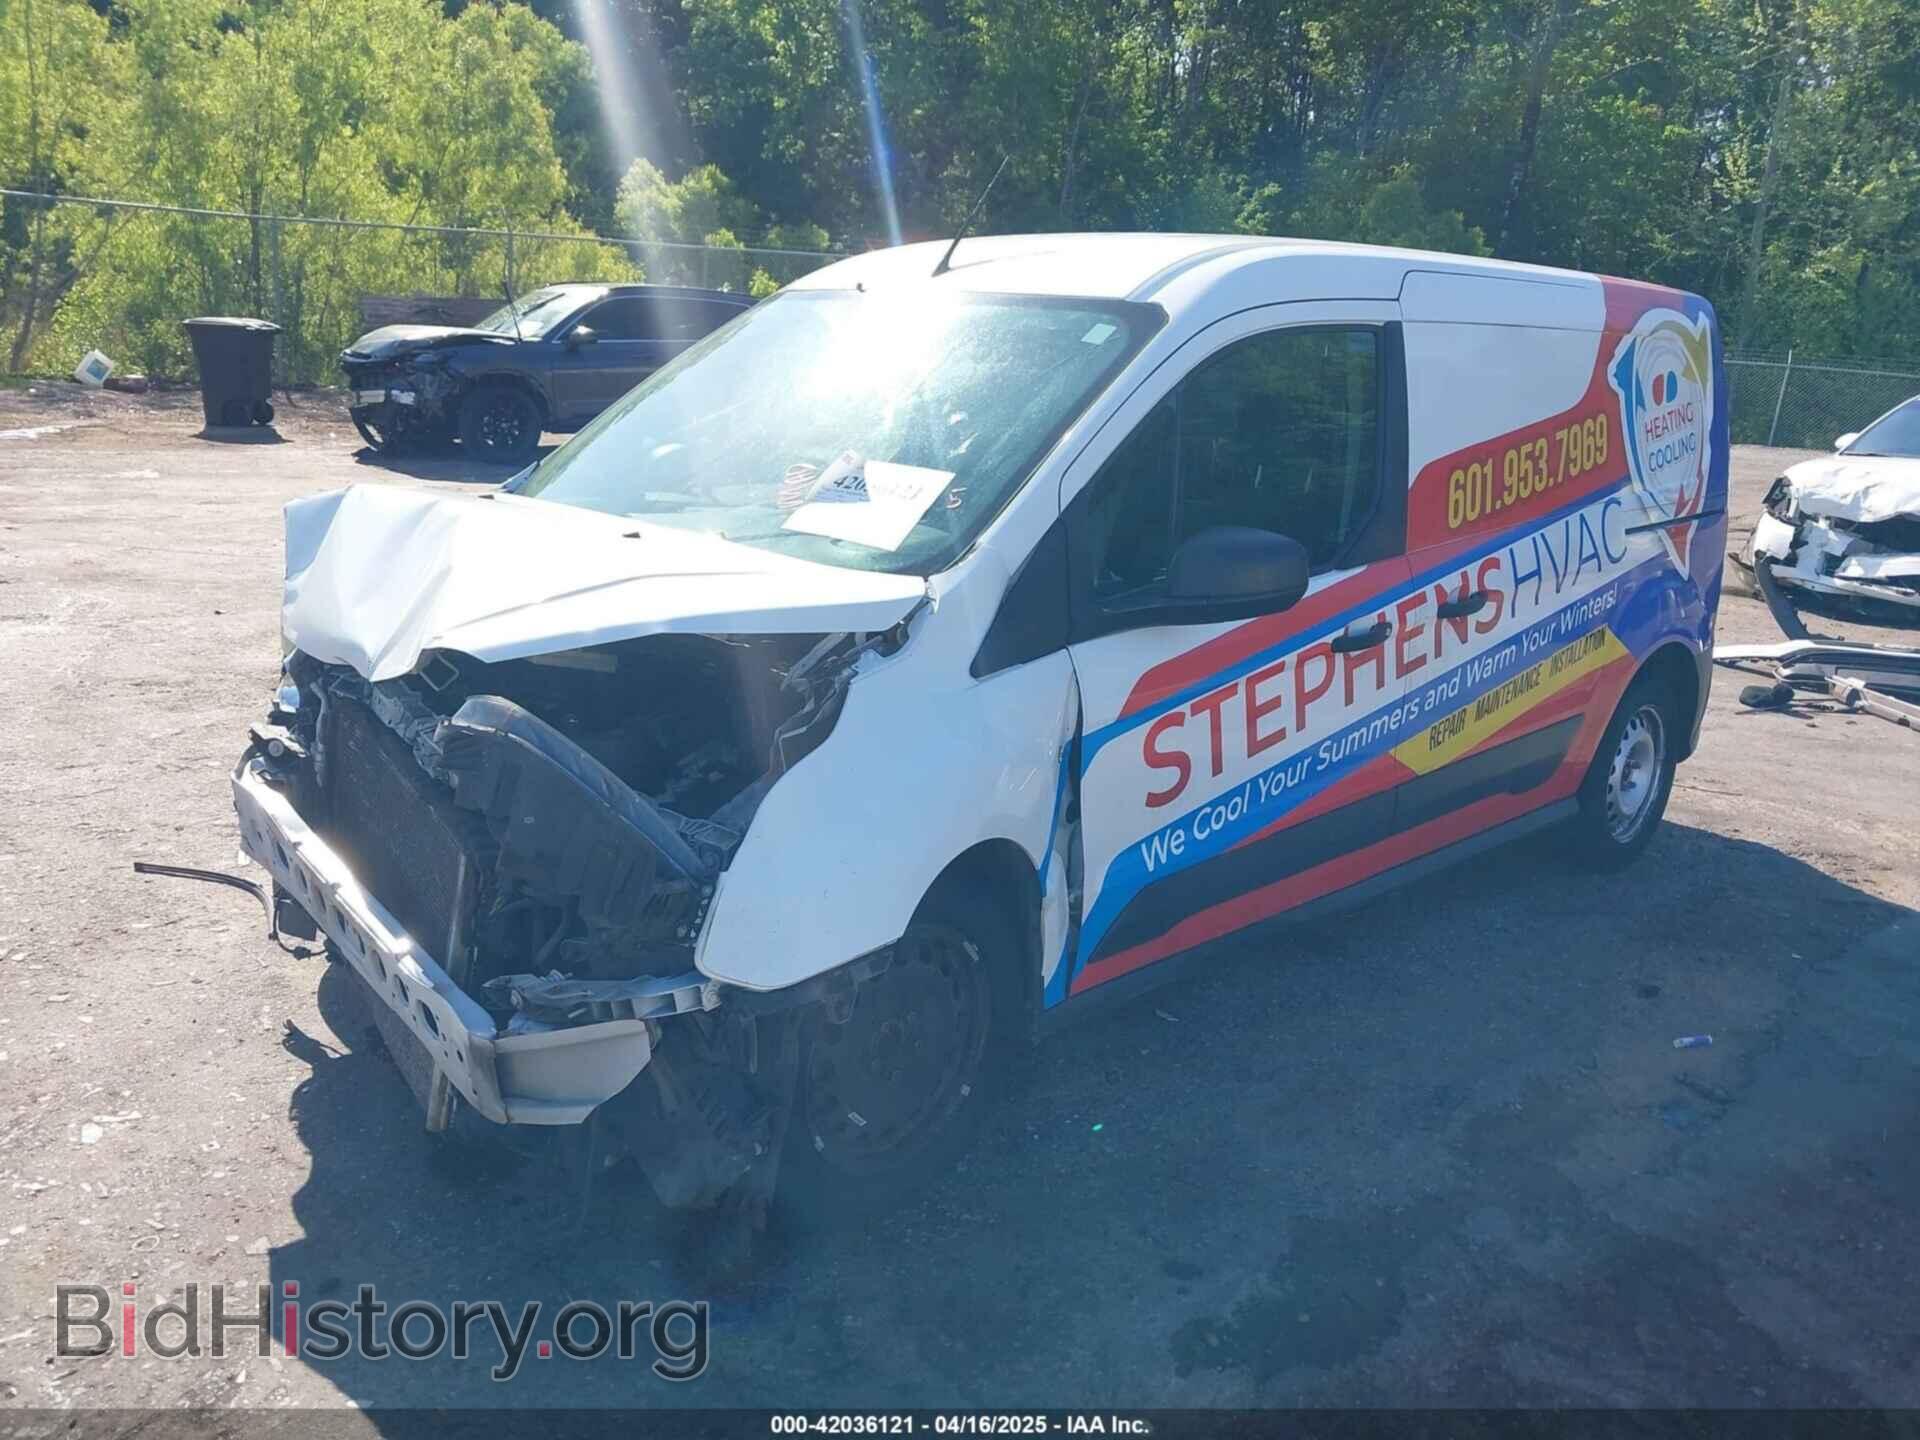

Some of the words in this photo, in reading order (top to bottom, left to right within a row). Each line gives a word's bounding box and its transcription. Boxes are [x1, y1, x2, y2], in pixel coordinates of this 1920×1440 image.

[1448, 413, 1608, 529] 601.953.7969
[1644, 402, 1695, 443] HEATING
[1648, 431, 1697, 473] COOLING
[1140, 828, 1186, 873] We
[1193, 783, 1250, 840] Cool
[1258, 756, 1313, 803] Your
[1316, 697, 1420, 772] Summers
[1424, 669, 1461, 711] and
[1466, 644, 1517, 690] Warm
[1521, 621, 1557, 657] Your
[1560, 583, 1618, 631] Winters!
[1429, 708, 1468, 752] REPAIR
[1473, 664, 1542, 723] MAINTENANCE
[1549, 627, 1607, 678] INSTALLATION
